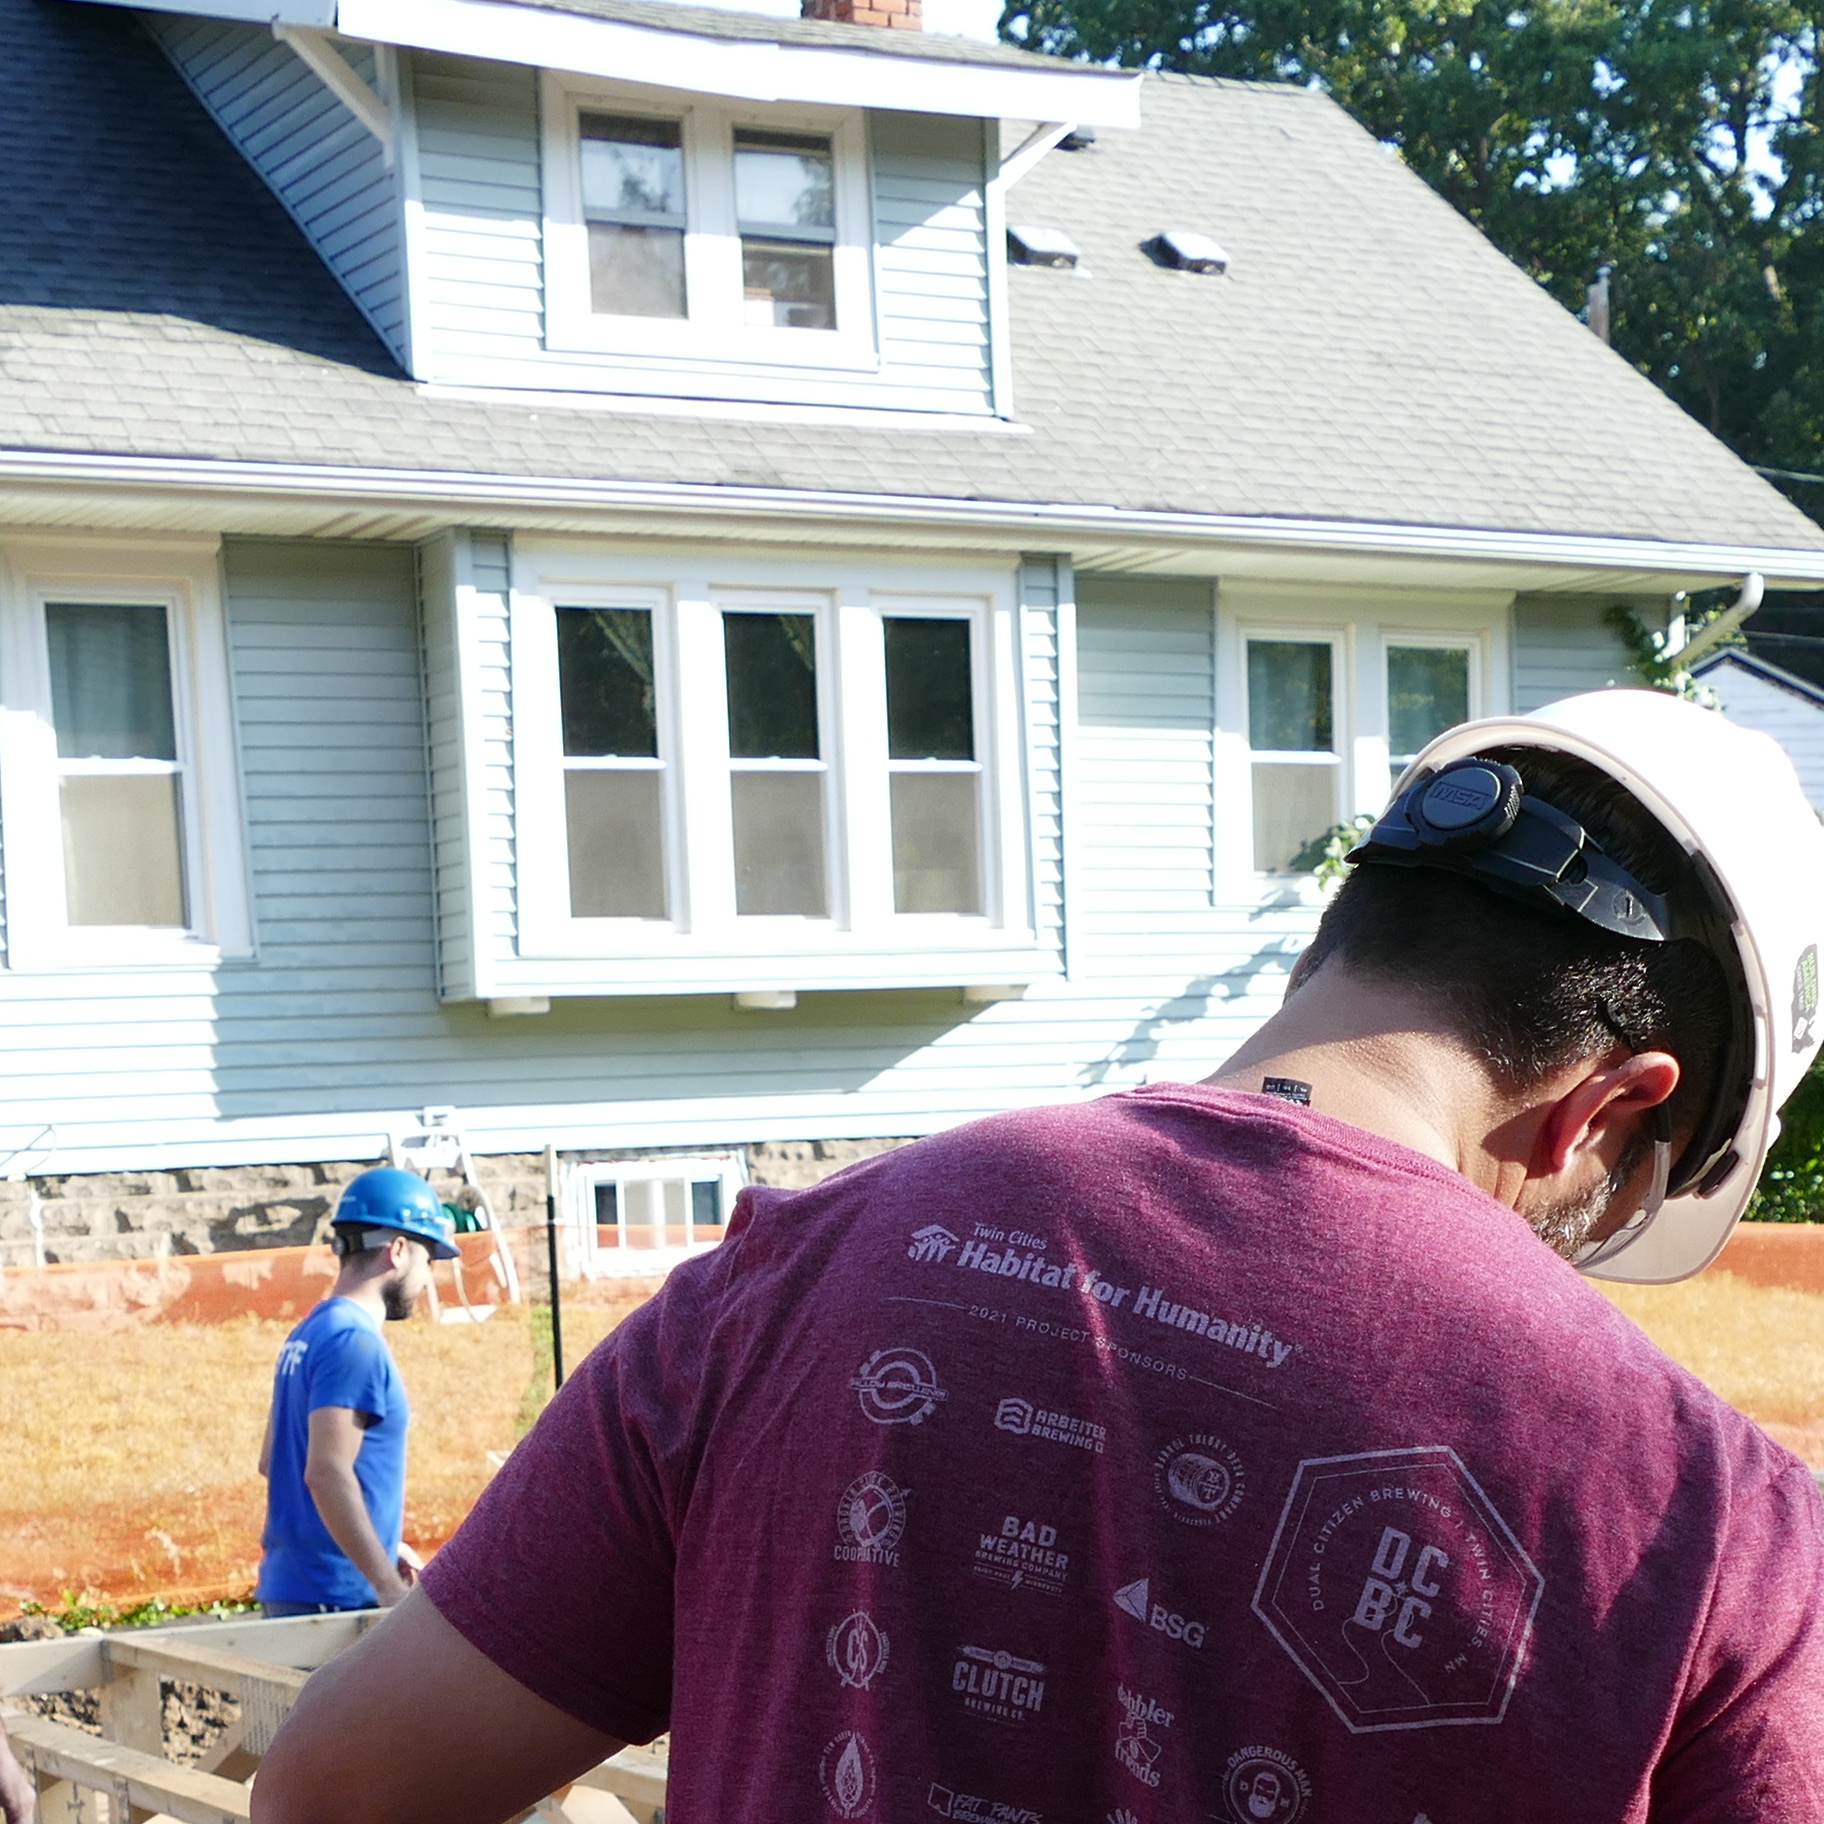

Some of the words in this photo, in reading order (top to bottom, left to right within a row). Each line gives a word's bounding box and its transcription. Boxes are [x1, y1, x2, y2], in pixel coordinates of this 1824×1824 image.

[1433, 785, 1487, 810] MSA
[973, 1222, 1005, 1242] Twin
[1008, 1230, 1049, 1251] Cities
[957, 1240, 1078, 1290] Habitat
[1080, 1269, 1130, 1307] for
[968, 1305, 1007, 1324] 2021
[1015, 1316, 1092, 1343] PROJECT
[1093, 1334, 1188, 1381] SPONSORS
[1031, 1424, 1093, 1451] BREWING
[1034, 1409, 1108, 1440] ARBEITER
[1370, 1487, 1452, 1518] BREWING
[1002, 1515, 1058, 1547] BAD
[1313, 1496, 1365, 1554] CITIZEN
[975, 1550, 1019, 1568] BREWING
[1022, 1561, 1069, 1583] COMPANY
[979, 1533, 1070, 1570] WEATHER
[1371, 1526, 1449, 1597] DC
[1465, 1532, 1491, 1580] TWIN
[1312, 1563, 1325, 1611] DUAL
[1150, 1603, 1207, 1649] BSG
[1353, 1577, 1432, 1649] BC
[1444, 1652, 1468, 1675] MN
[952, 1661, 1045, 1713] CLUTCH
[1227, 1744, 1297, 1773] DANGEROUS
[1295, 1768, 1313, 1798] MAN
[953, 1793, 989, 1810] FAT
